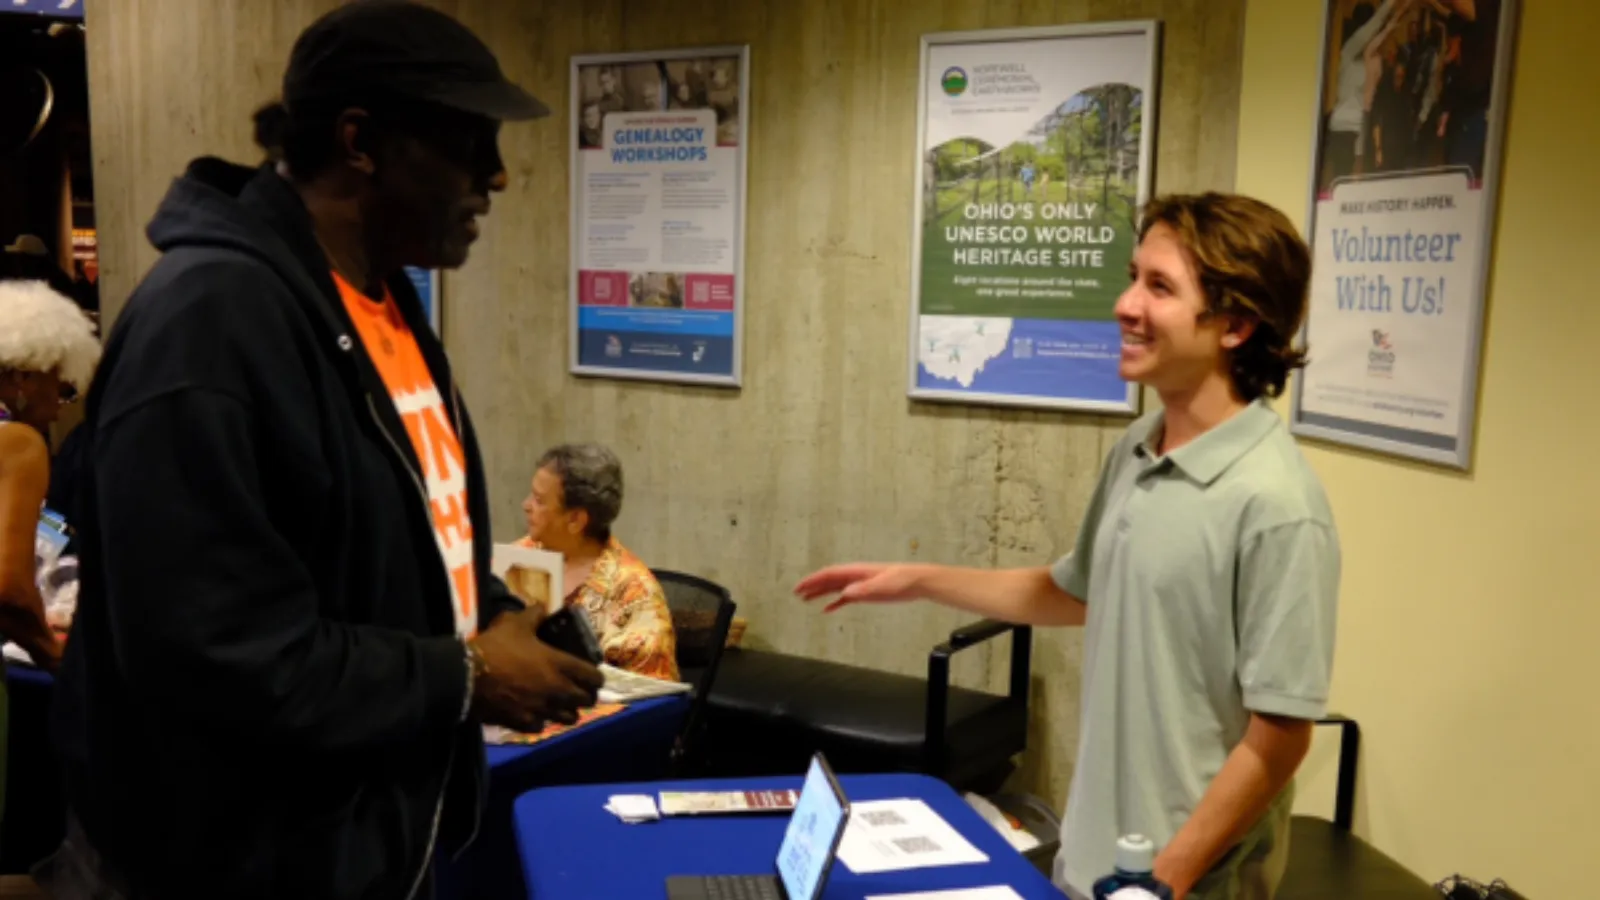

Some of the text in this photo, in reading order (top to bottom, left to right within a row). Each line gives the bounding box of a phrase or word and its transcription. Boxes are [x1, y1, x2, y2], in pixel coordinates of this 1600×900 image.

[613, 128, 704, 145] GENEALOGY
[612, 146, 708, 164] WORKSHOPS
[964, 202, 1097, 219] OHIO'S ONLY
[1367, 198, 1408, 213] HISTORY
[1411, 194, 1456, 211] HAPPEN.
[945, 226, 1115, 244] UNESCO WORLD
[1332, 225, 1462, 263] Volunteer
[953, 248, 1104, 267] HERITAGE SITE
[1335, 274, 1446, 316] With Us!
